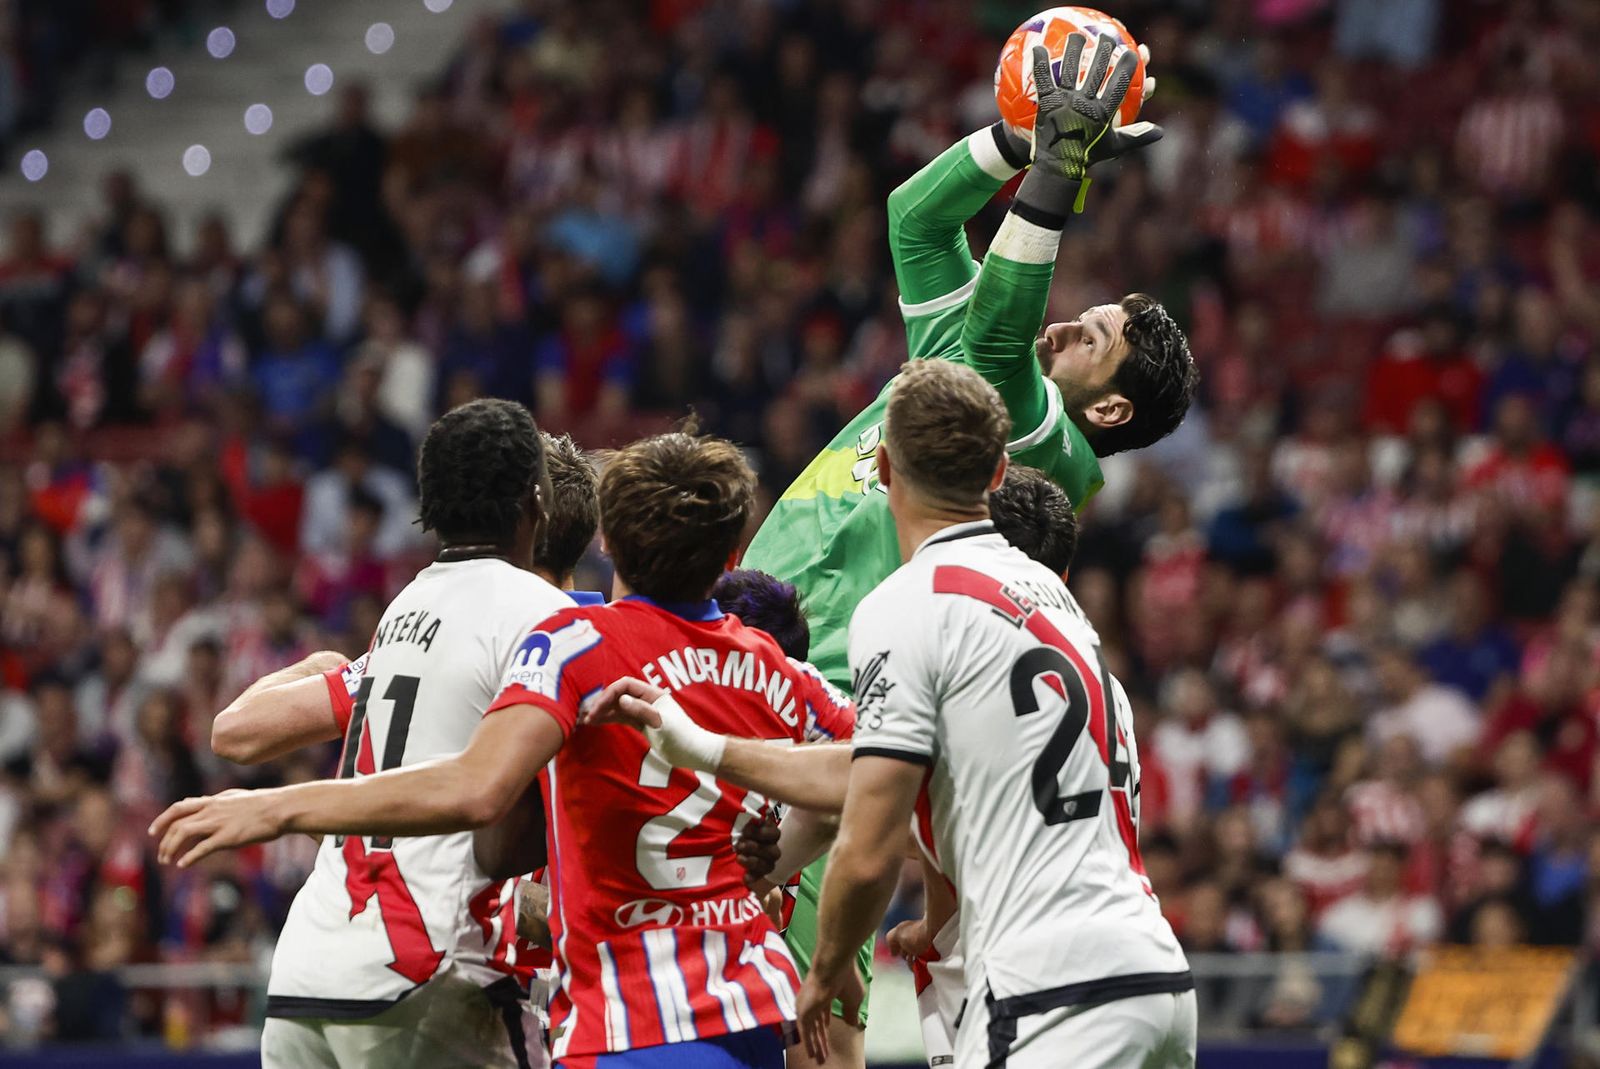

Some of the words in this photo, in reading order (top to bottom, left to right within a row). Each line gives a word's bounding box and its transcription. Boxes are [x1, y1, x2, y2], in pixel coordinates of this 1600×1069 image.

[991, 580, 1090, 630] LEJEUN
[509, 671, 544, 683] ken
[641, 646, 798, 727] ENORMAND
